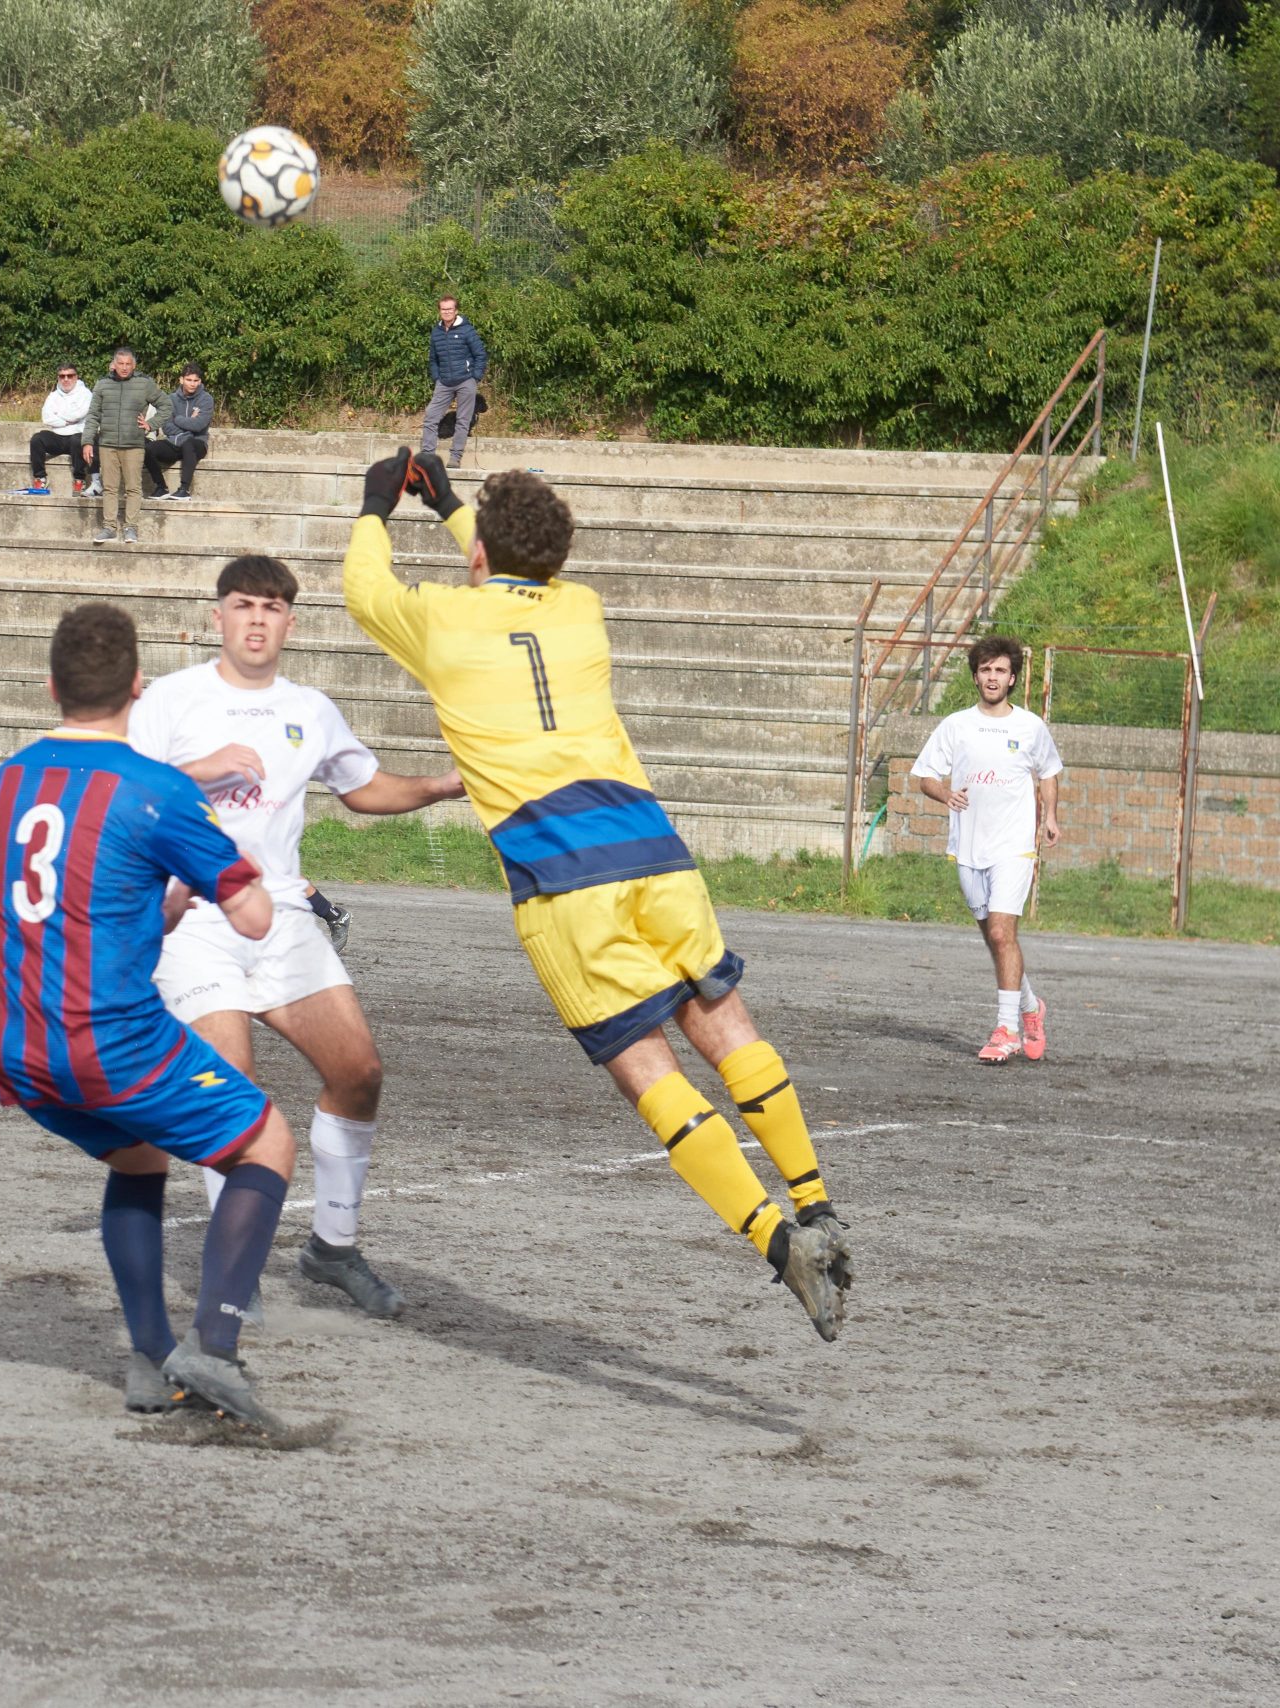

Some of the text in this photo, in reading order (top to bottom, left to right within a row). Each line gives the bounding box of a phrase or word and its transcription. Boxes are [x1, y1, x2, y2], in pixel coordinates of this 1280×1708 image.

[506, 584, 544, 601] Zeus
[509, 632, 557, 731] 1
[12, 803, 65, 923] 3
